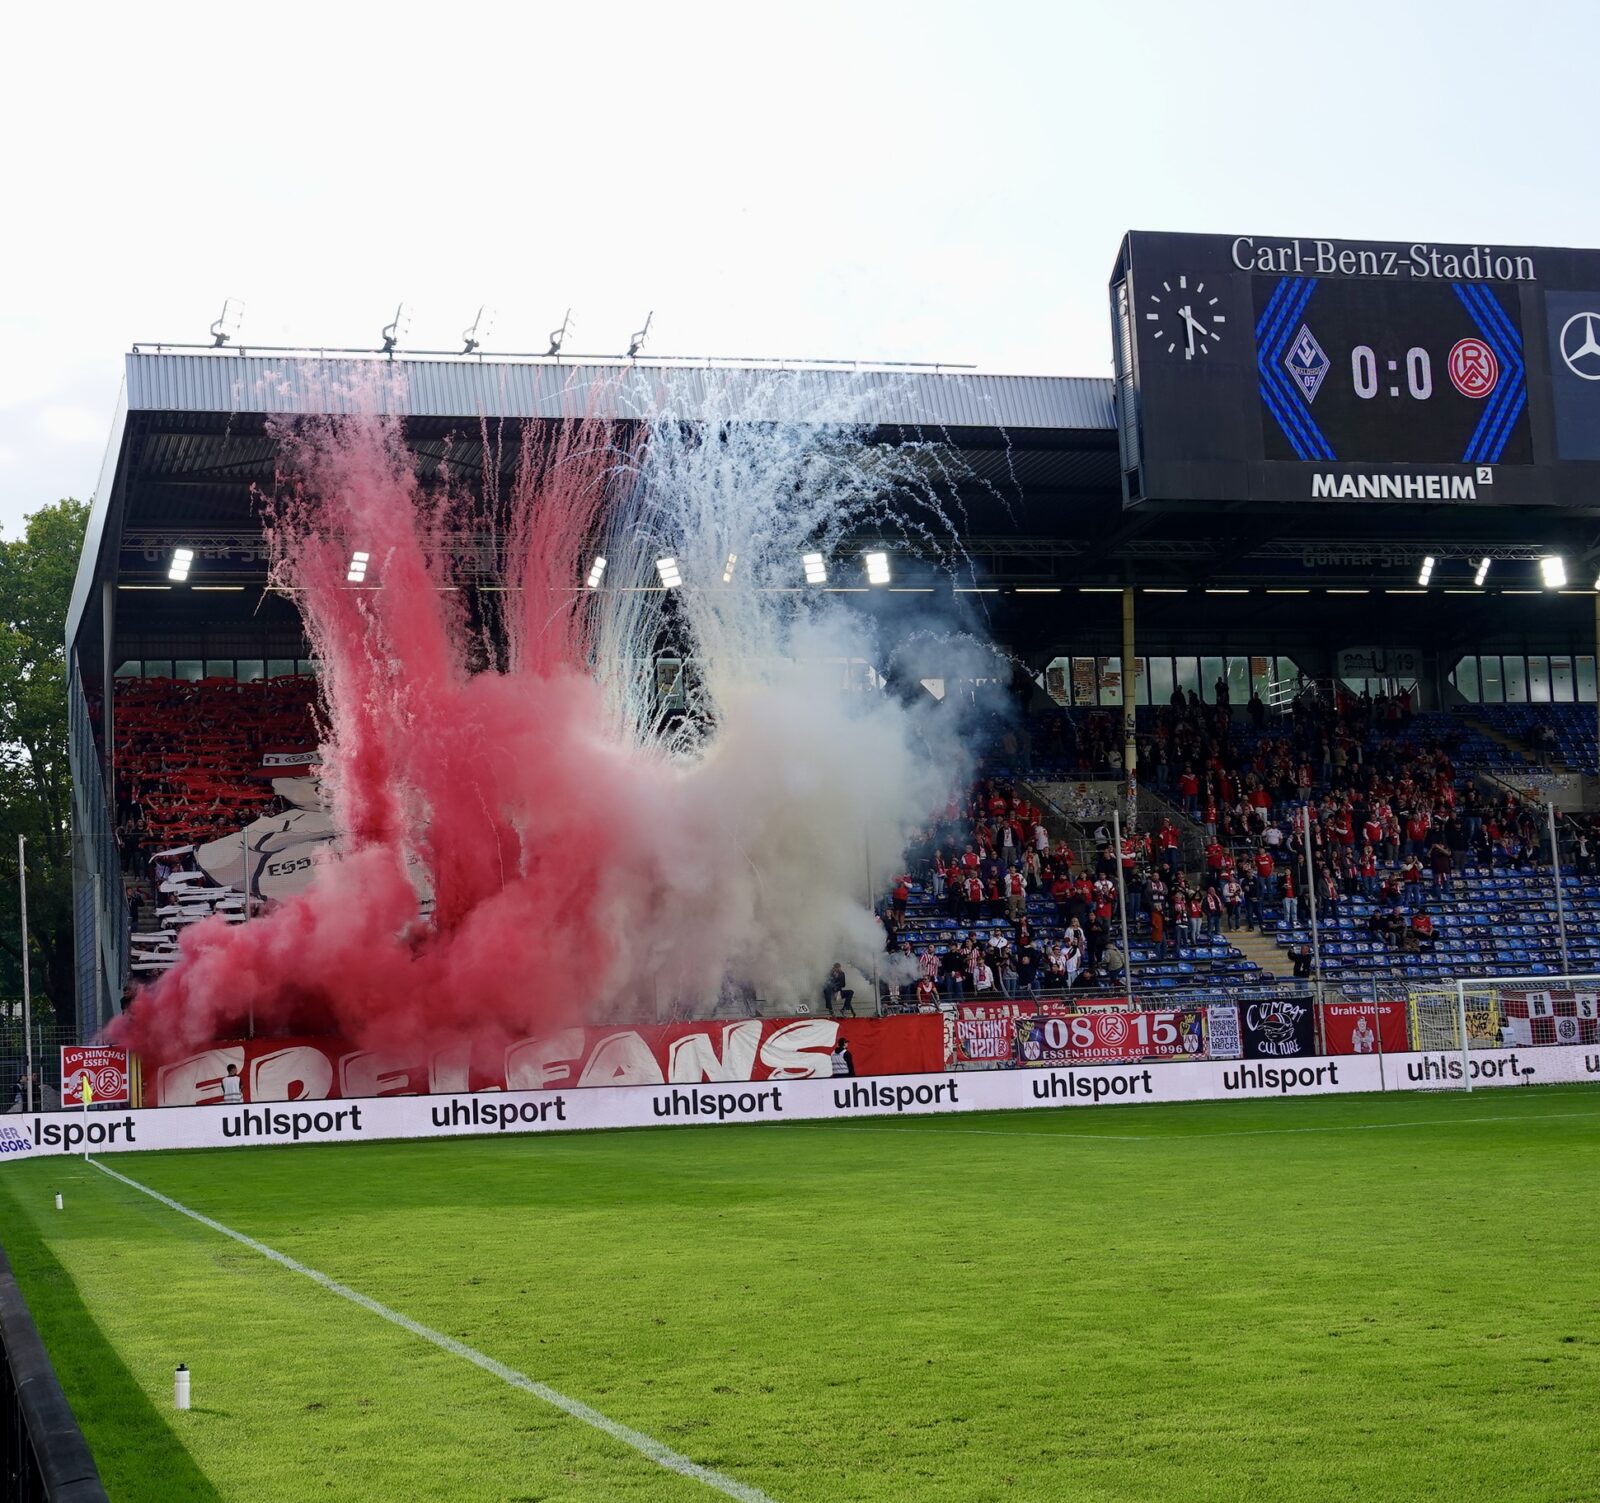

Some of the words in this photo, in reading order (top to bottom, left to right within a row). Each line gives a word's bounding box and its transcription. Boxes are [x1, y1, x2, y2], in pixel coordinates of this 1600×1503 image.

[1232, 236, 1537, 281] Carl-Benz-Stadion
[1304, 376, 1316, 387] 07
[1044, 1017, 1095, 1049] 08
[1130, 1014, 1178, 1045] 15
[1209, 1019, 1237, 1027] MISSING
[65, 1052, 84, 1064] LOS
[85, 1050, 126, 1061] HINCHAS
[83, 1059, 110, 1067] ESSEN
[1043, 1047, 1124, 1060] ESSEN-HORST
[1129, 1046, 1150, 1055] seit
[1155, 1045, 1183, 1054] 1996
[1258, 1039, 1302, 1056] CULTURE
[1031, 1068, 1153, 1103] uhlsport
[1222, 1061, 1339, 1093] uhlsport
[652, 1086, 783, 1120] uhlsport
[833, 1078, 959, 1112] uhlsport
[222, 1105, 362, 1140] uhlsport
[431, 1095, 567, 1130] uhlsport
[27, 1116, 136, 1151] lsport
